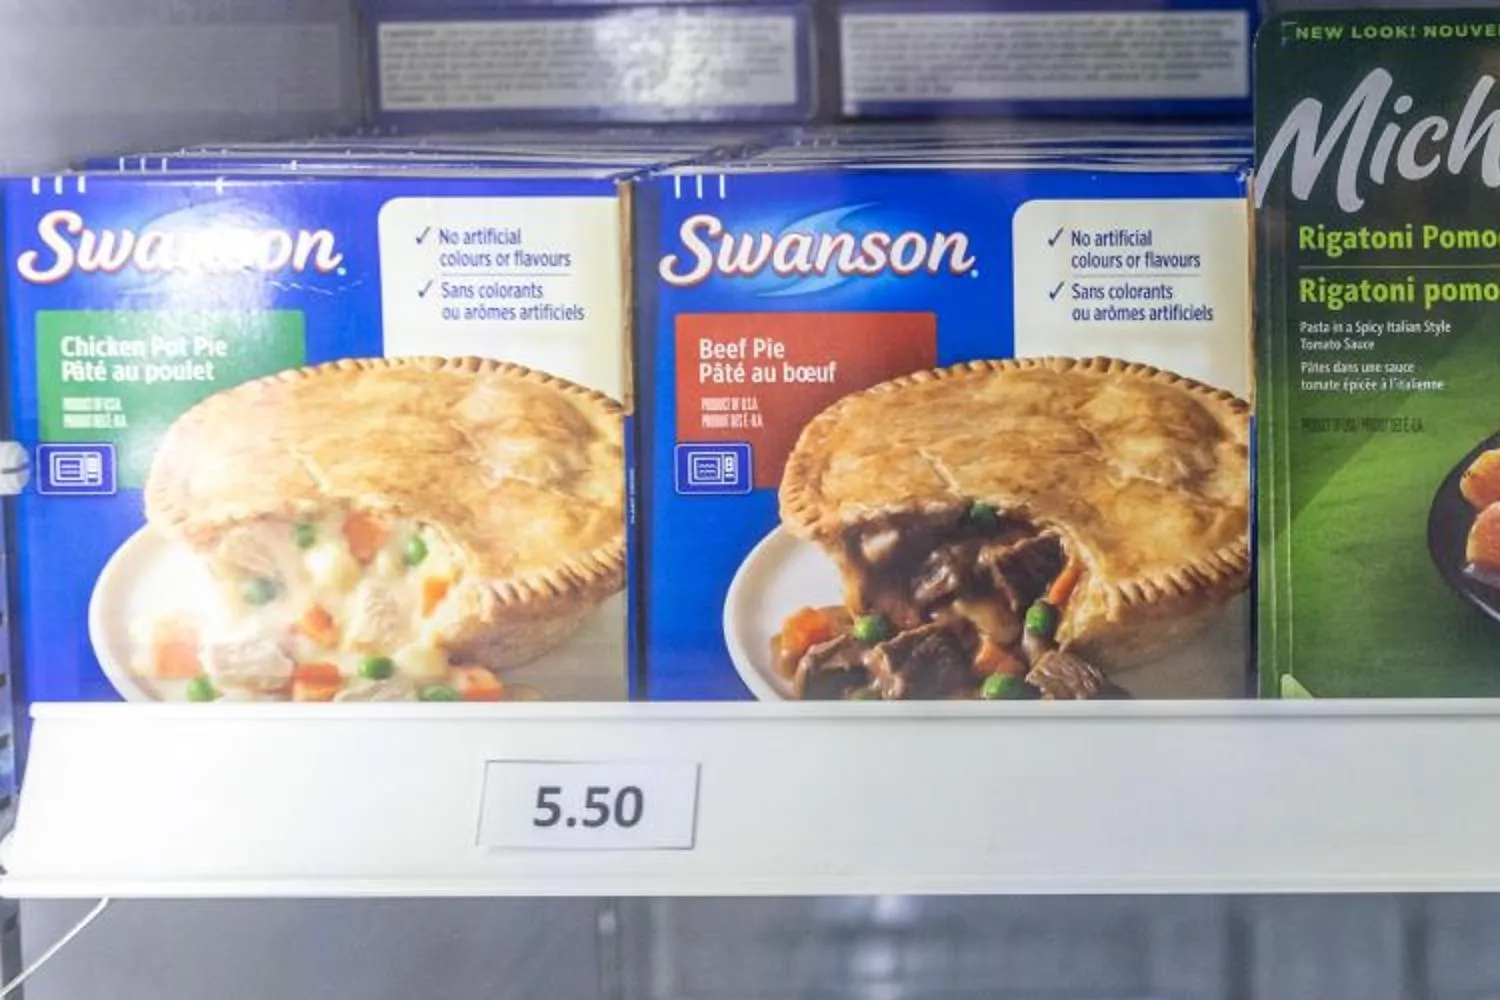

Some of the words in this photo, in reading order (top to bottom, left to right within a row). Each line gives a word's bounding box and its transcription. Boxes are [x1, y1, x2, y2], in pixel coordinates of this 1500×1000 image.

[1295, 26, 1343, 40] NEW
[1352, 25, 1416, 39] LOOK!
[439, 229, 460, 245] No
[463, 228, 521, 245] artificial
[1071, 230, 1090, 247] No
[1095, 229, 1153, 247] artificial
[1299, 224, 1413, 258] Rigatoni
[439, 250, 492, 267] colours
[495, 253, 510, 267] or
[514, 250, 572, 267] flavours
[659, 213, 976, 287] Swanson
[1071, 252, 1123, 269] colours
[1126, 255, 1141, 268] or
[1145, 251, 1201, 268] flavours
[440, 282, 475, 299] Sans
[478, 282, 544, 299] colorants
[1071, 283, 1105, 300] Sans
[1108, 281, 1173, 300] colorants
[1300, 275, 1415, 311] Rigatoni
[442, 307, 460, 320] ou
[464, 303, 516, 321] arômes
[519, 303, 585, 321] artificiels
[1072, 307, 1090, 321] ou
[1093, 304, 1145, 321] arômes
[1150, 303, 1214, 321] artificiels
[1300, 321, 1330, 333] Pasta
[1333, 321, 1343, 333] in
[1345, 324, 1353, 333] a
[1355, 320, 1384, 336] Spicy
[1387, 320, 1422, 333] Italian
[1424, 320, 1452, 336] Style
[60, 335, 145, 357] Chicken
[151, 336, 188, 357] Pot
[194, 335, 228, 357] Pie
[699, 338, 747, 361] Beef
[753, 338, 785, 360] Pie
[1300, 337, 1342, 350] Tomato
[1344, 337, 1375, 350] Sauce
[62, 359, 107, 382] Pâté
[112, 364, 139, 382] au
[145, 359, 215, 384] poulet
[699, 361, 745, 384] Pâté
[751, 367, 777, 384] au
[783, 361, 837, 384] bœuf
[1333, 361, 1359, 373] dans
[1385, 363, 1415, 373] sauce
[1301, 379, 1341, 391] tomate
[532, 785, 645, 829] 5.50
